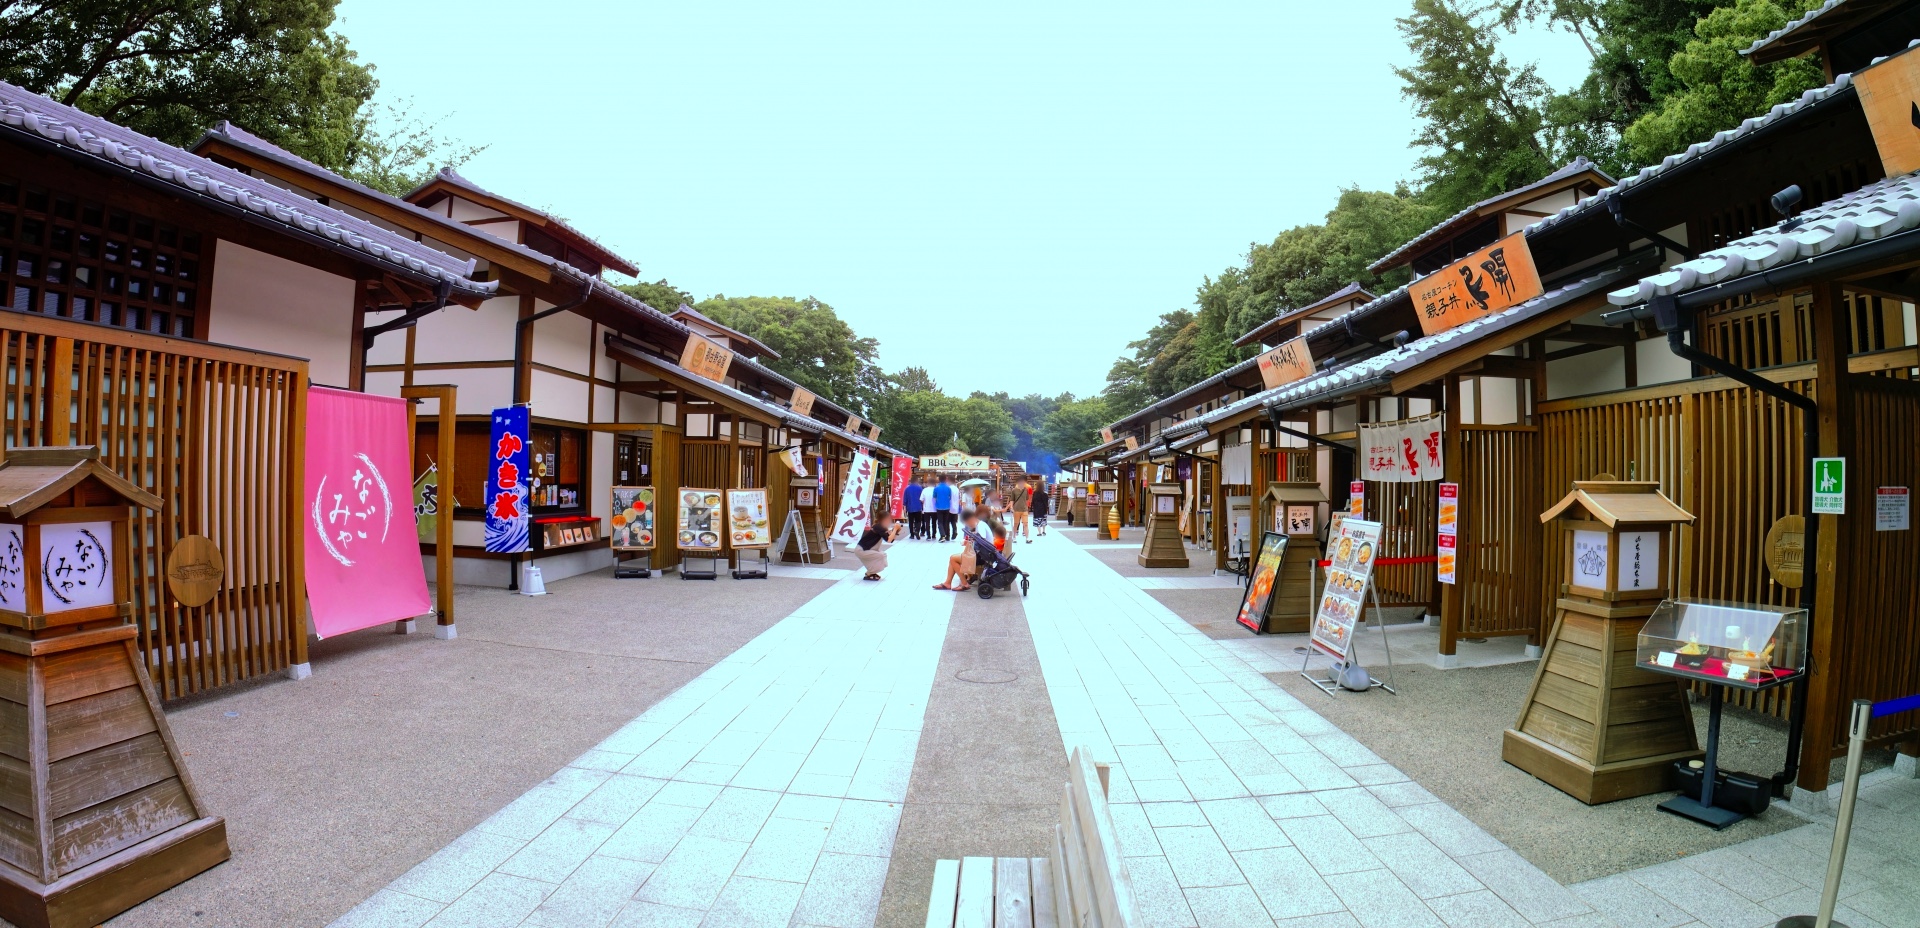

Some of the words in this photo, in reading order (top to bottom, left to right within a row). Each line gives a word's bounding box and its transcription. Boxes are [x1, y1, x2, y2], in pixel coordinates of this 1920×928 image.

[1421, 279, 1457, 301] 名古屋コーチン
[1425, 292, 1461, 319] 親子丼
[494, 431, 523, 520] かき氷
[928, 458, 946, 467] BBQ
[352, 469, 376, 539] なご
[613, 490, 634, 499] TAKE
[614, 499, 634, 508] OUT
[838, 459, 871, 538] きしめん
[75, 539, 95, 586] なご
